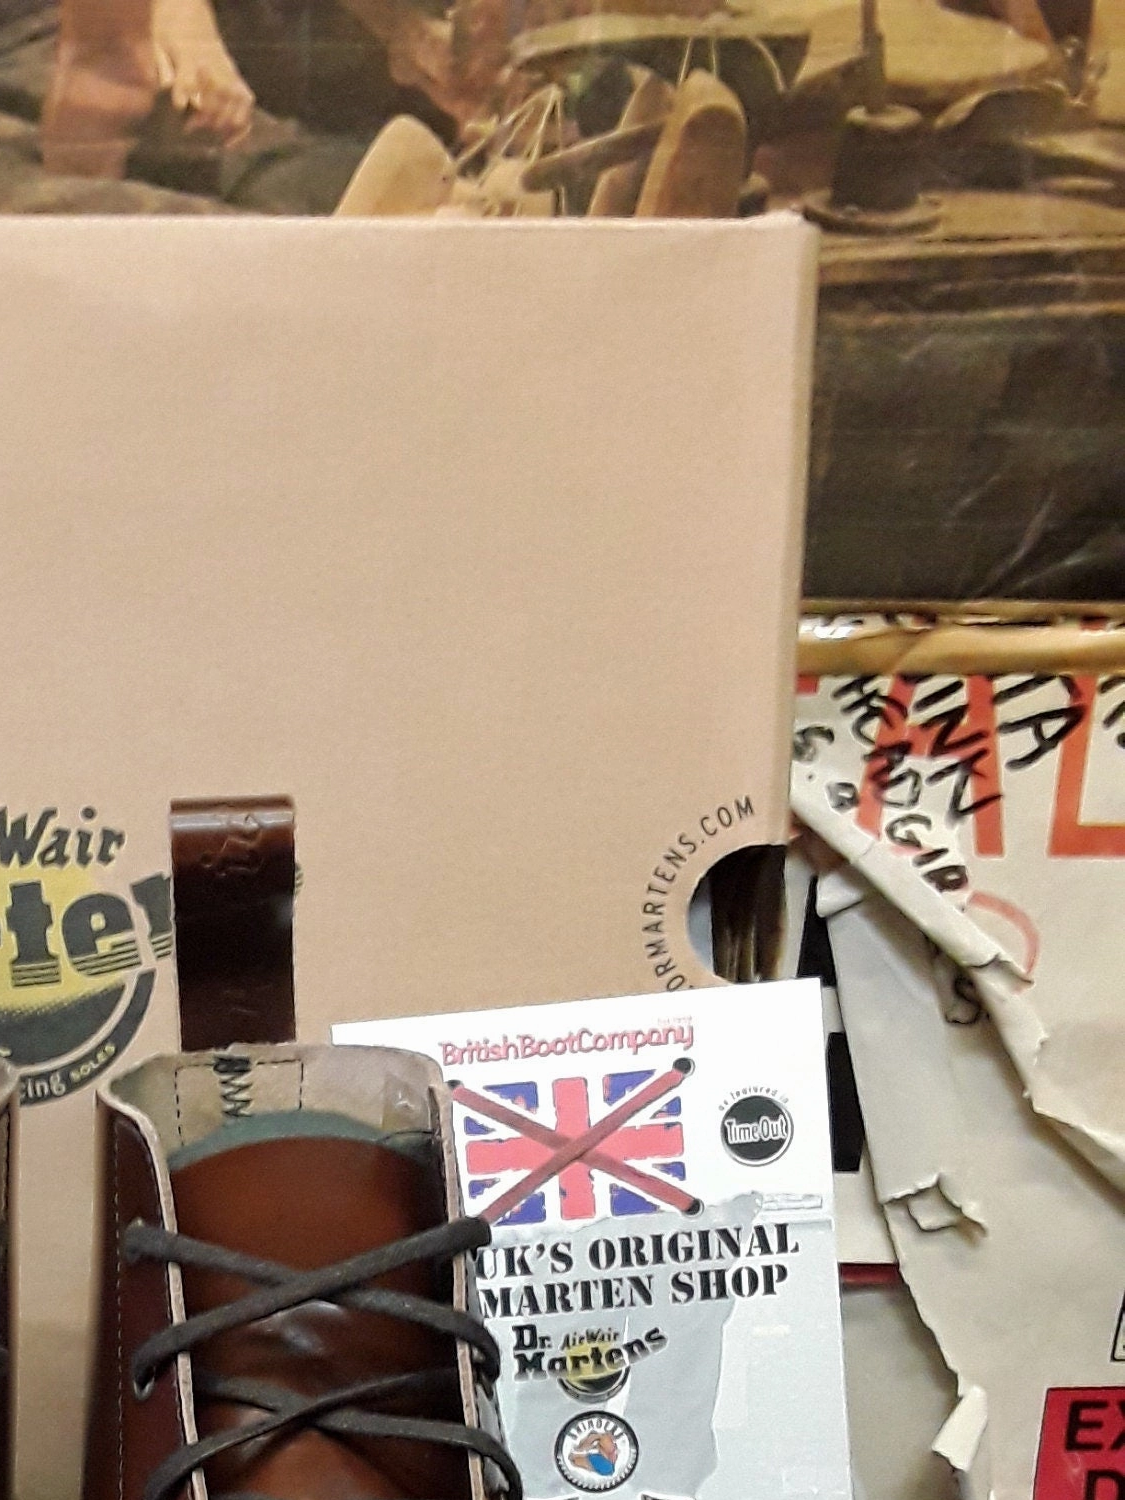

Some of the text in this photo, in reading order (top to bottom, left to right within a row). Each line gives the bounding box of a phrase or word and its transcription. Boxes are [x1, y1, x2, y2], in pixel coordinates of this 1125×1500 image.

[439, 1024, 694, 1067] BritishBootCompany
[476, 1223, 800, 1281] UK'S ORIGINAL
[479, 1264, 789, 1319] MARTEN SHOP
[514, 1327, 668, 1381] Martens
